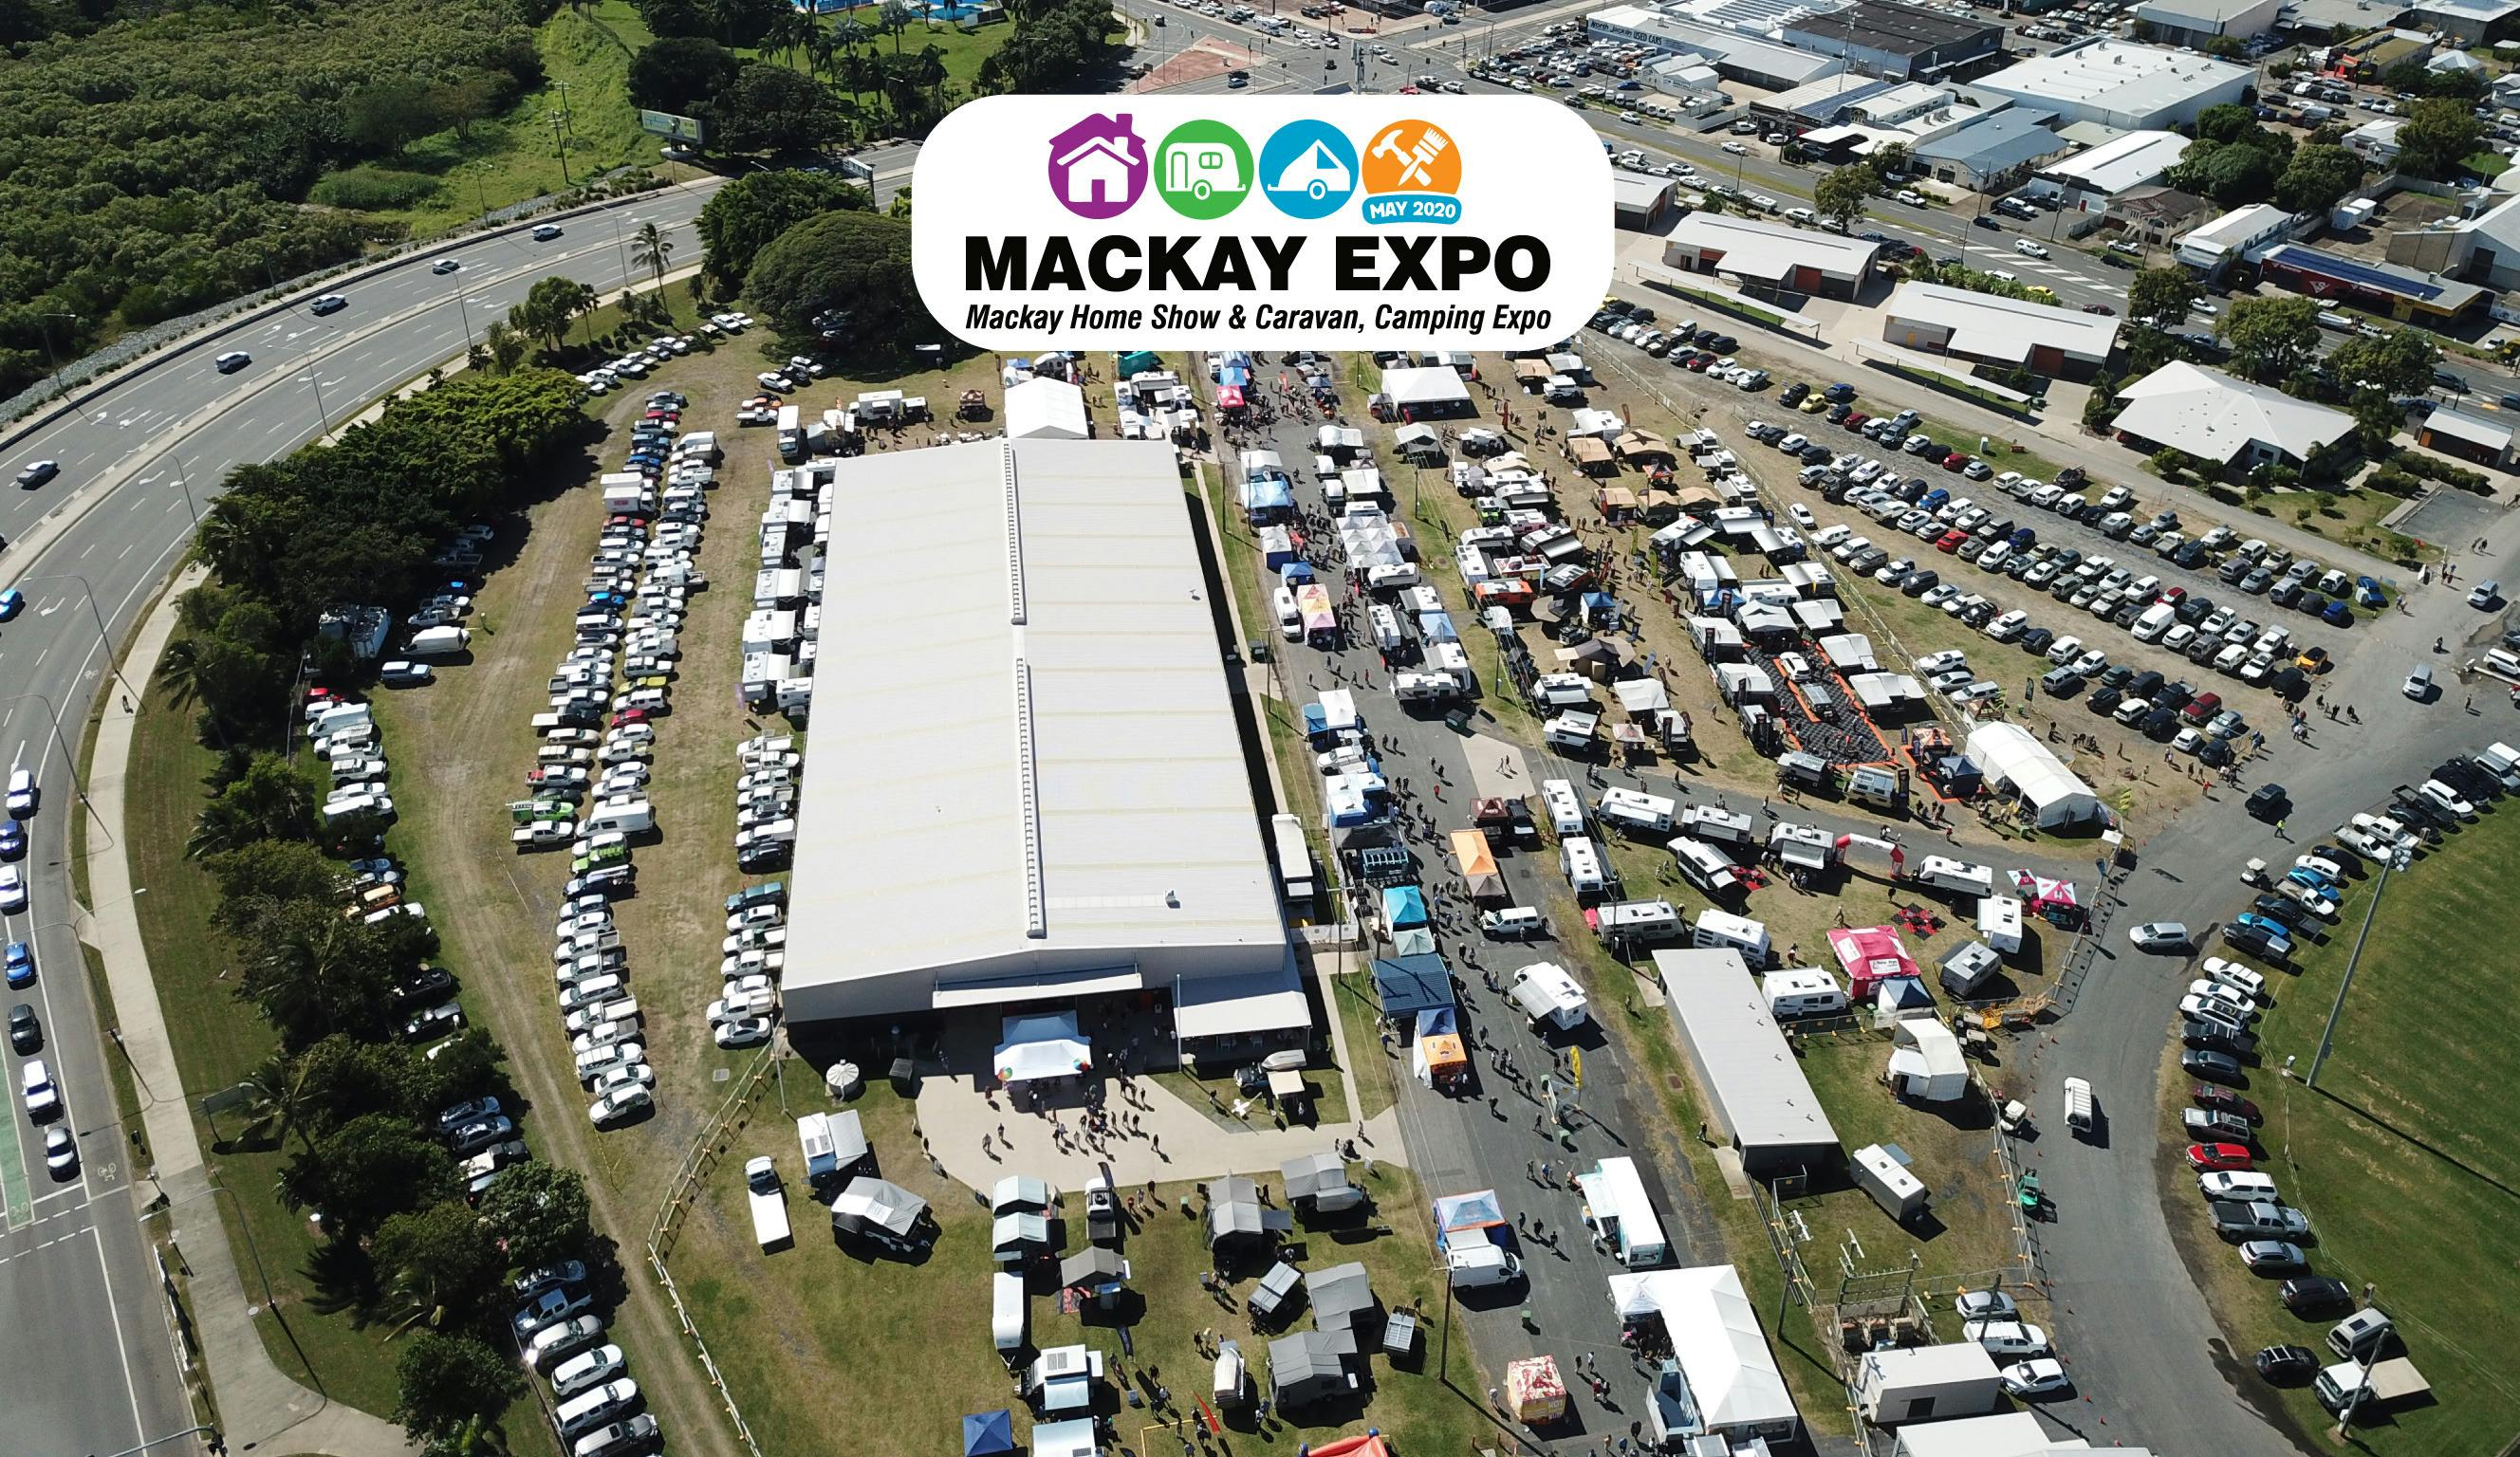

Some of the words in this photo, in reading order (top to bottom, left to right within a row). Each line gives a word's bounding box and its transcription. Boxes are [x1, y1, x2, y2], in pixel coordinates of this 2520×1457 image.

[1590, 20, 1609, 30] North
[1633, 30, 1648, 43] USED
[1648, 34, 1662, 46] CARS
